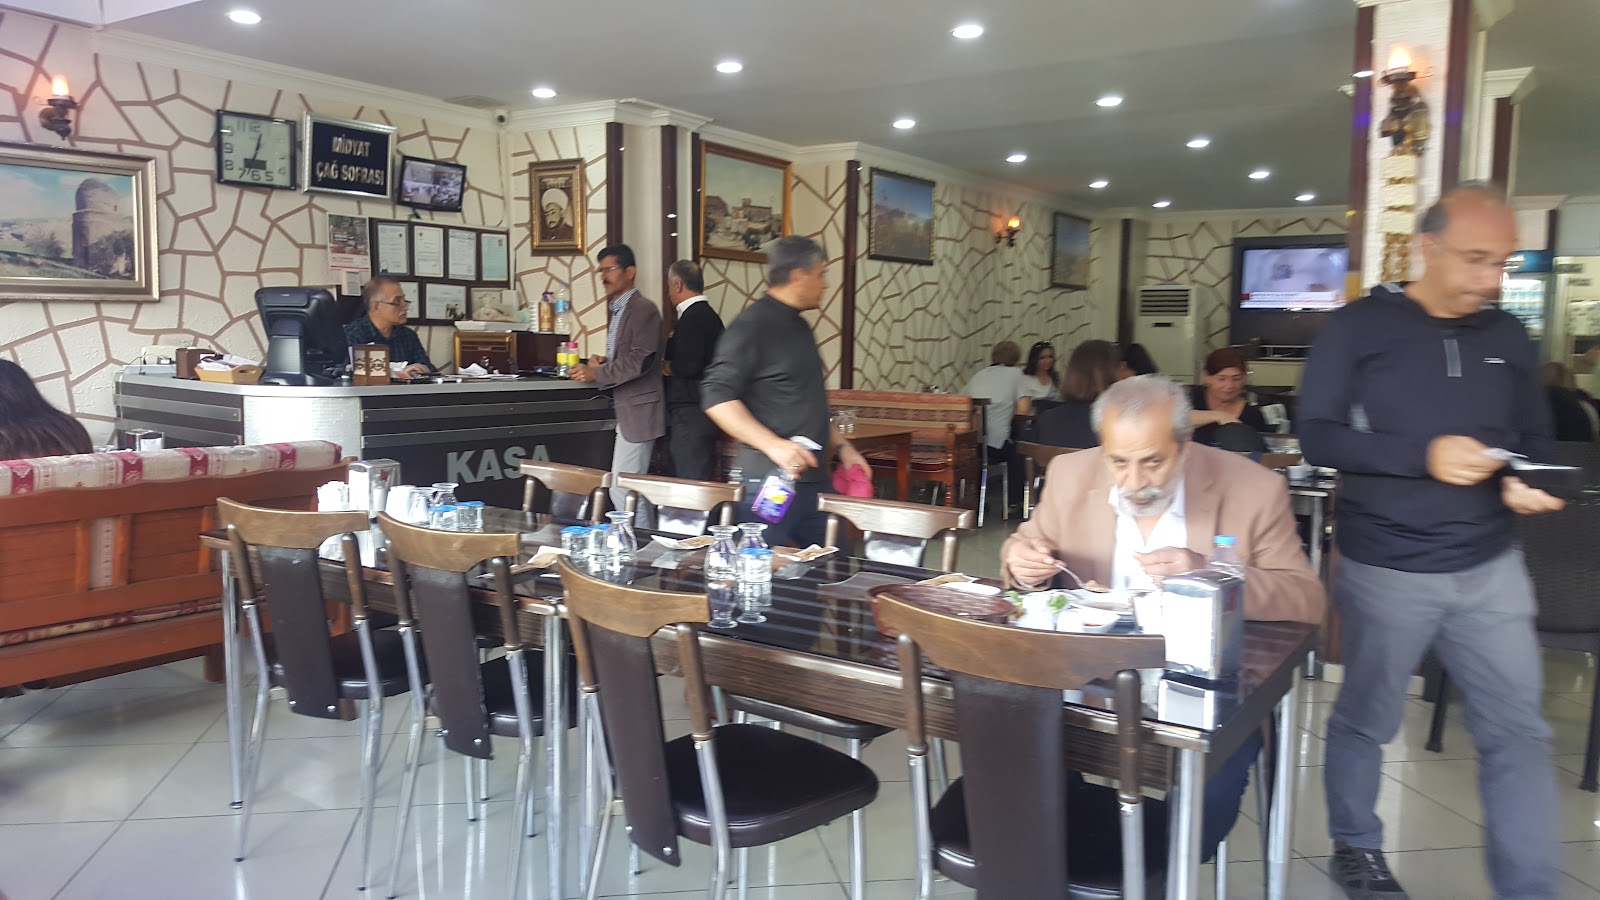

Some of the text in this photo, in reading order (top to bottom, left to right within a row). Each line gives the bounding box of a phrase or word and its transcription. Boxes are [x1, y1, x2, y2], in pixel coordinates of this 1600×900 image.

[223, 142, 234, 154] 9
[332, 133, 371, 156] MİDYAT
[224, 159, 234, 171] 8
[238, 167, 247, 179] 7
[251, 170, 261, 182] 6
[265, 171, 274, 182] 5
[316, 159, 384, 185] ÇAĞ SOFRASI
